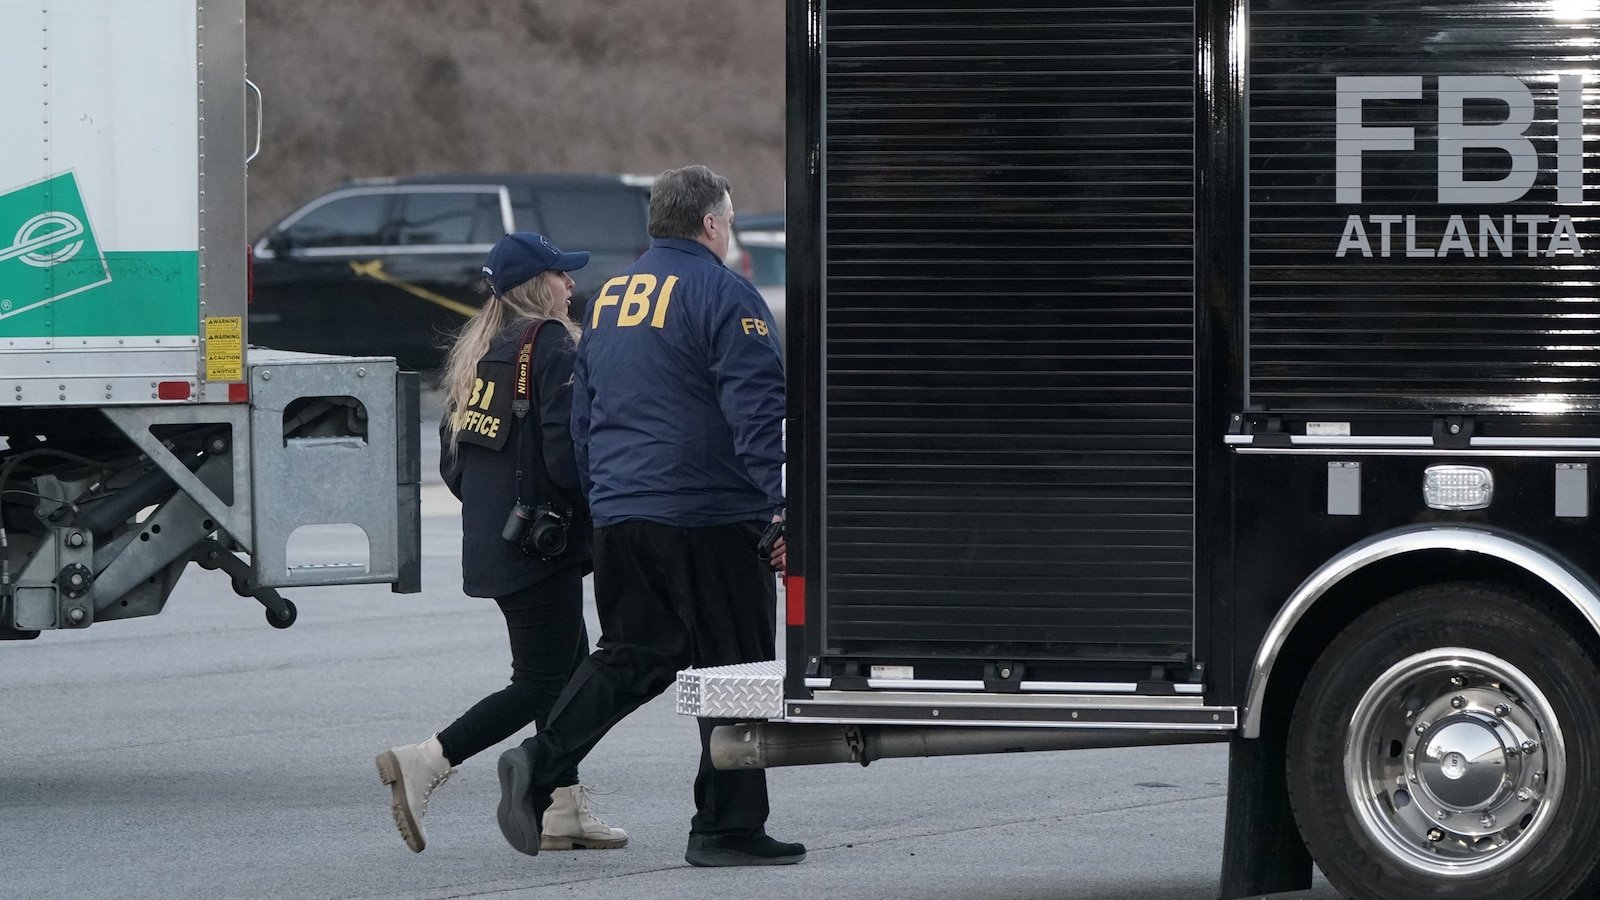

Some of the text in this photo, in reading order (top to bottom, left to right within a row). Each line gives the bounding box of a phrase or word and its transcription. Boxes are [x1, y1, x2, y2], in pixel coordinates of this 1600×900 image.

[1336, 75, 1583, 204] FBI
[1335, 214, 1584, 258] ATLANTA
[591, 273, 679, 330] FBI
[467, 377, 496, 411] BI
[518, 363, 527, 395] Nikon
